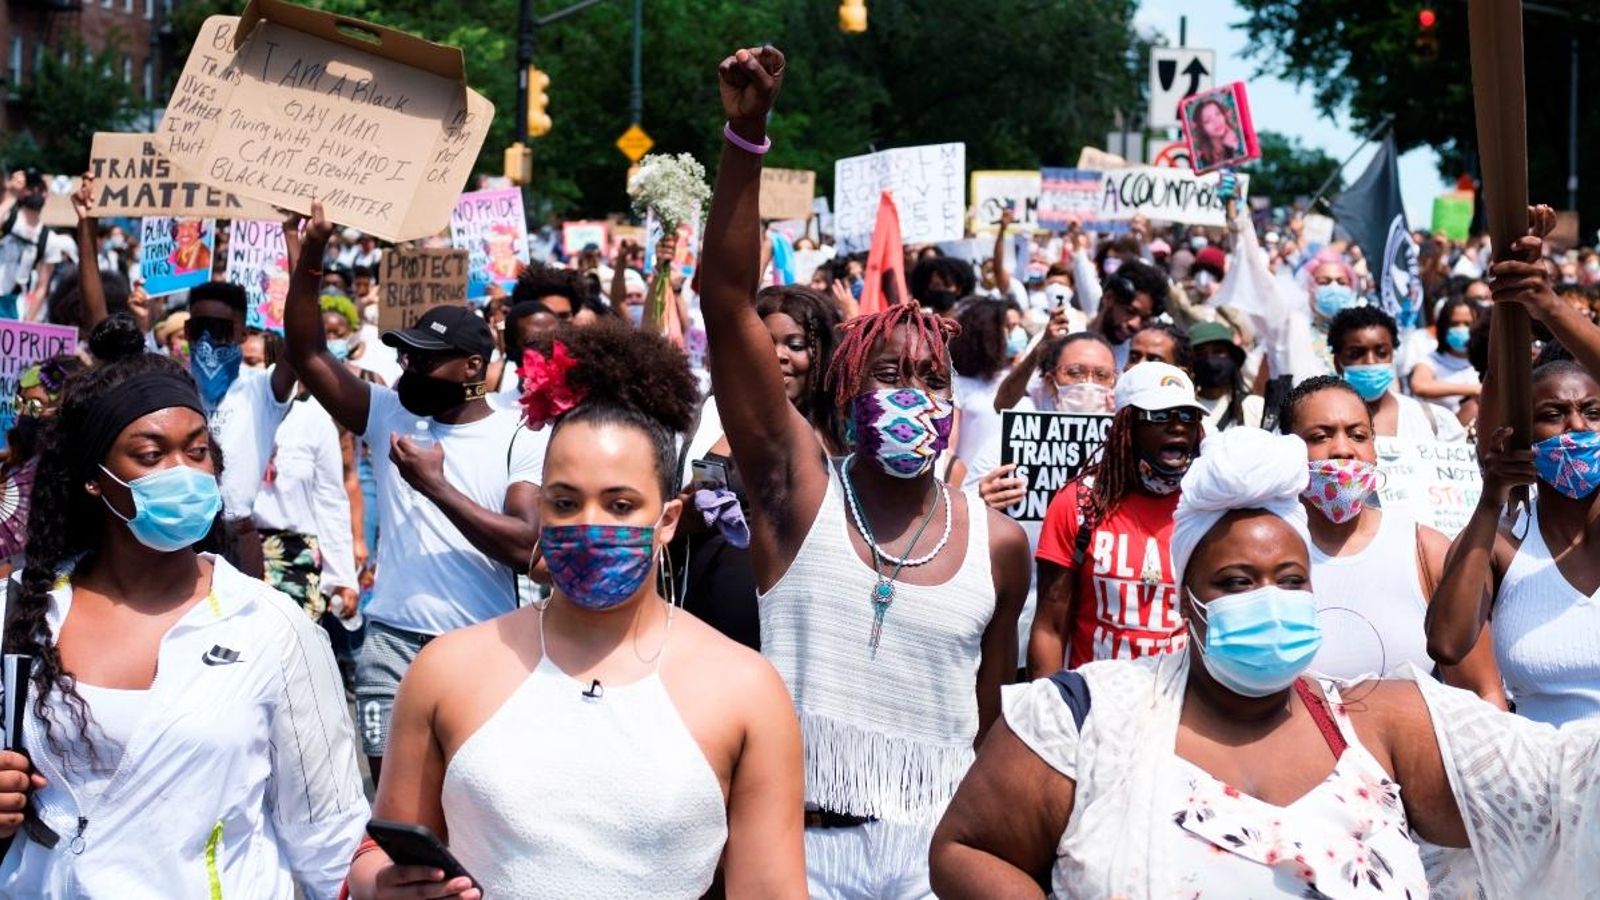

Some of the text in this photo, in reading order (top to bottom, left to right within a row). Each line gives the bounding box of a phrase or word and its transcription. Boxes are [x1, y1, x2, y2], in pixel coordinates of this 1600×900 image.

[283, 99, 330, 133] GAY
[169, 135, 205, 155] Hurt
[316, 139, 354, 157] HIV
[91, 158, 171, 179] TRANS
[98, 182, 243, 208] MATTER
[210, 156, 394, 221] BLACK LIVES MATTER
[453, 195, 521, 223] NO PRIDE
[234, 220, 260, 247] NO
[387, 250, 467, 279] PROTECT
[19, 330, 74, 359] PRIDE
[1009, 414, 1114, 442] AN ATTAC
[1009, 440, 1081, 467] TRANS
[1034, 466, 1068, 491] AN
[1435, 466, 1477, 482] NOT
[1093, 530, 1174, 581] BLA
[1098, 578, 1178, 631] LIVE
